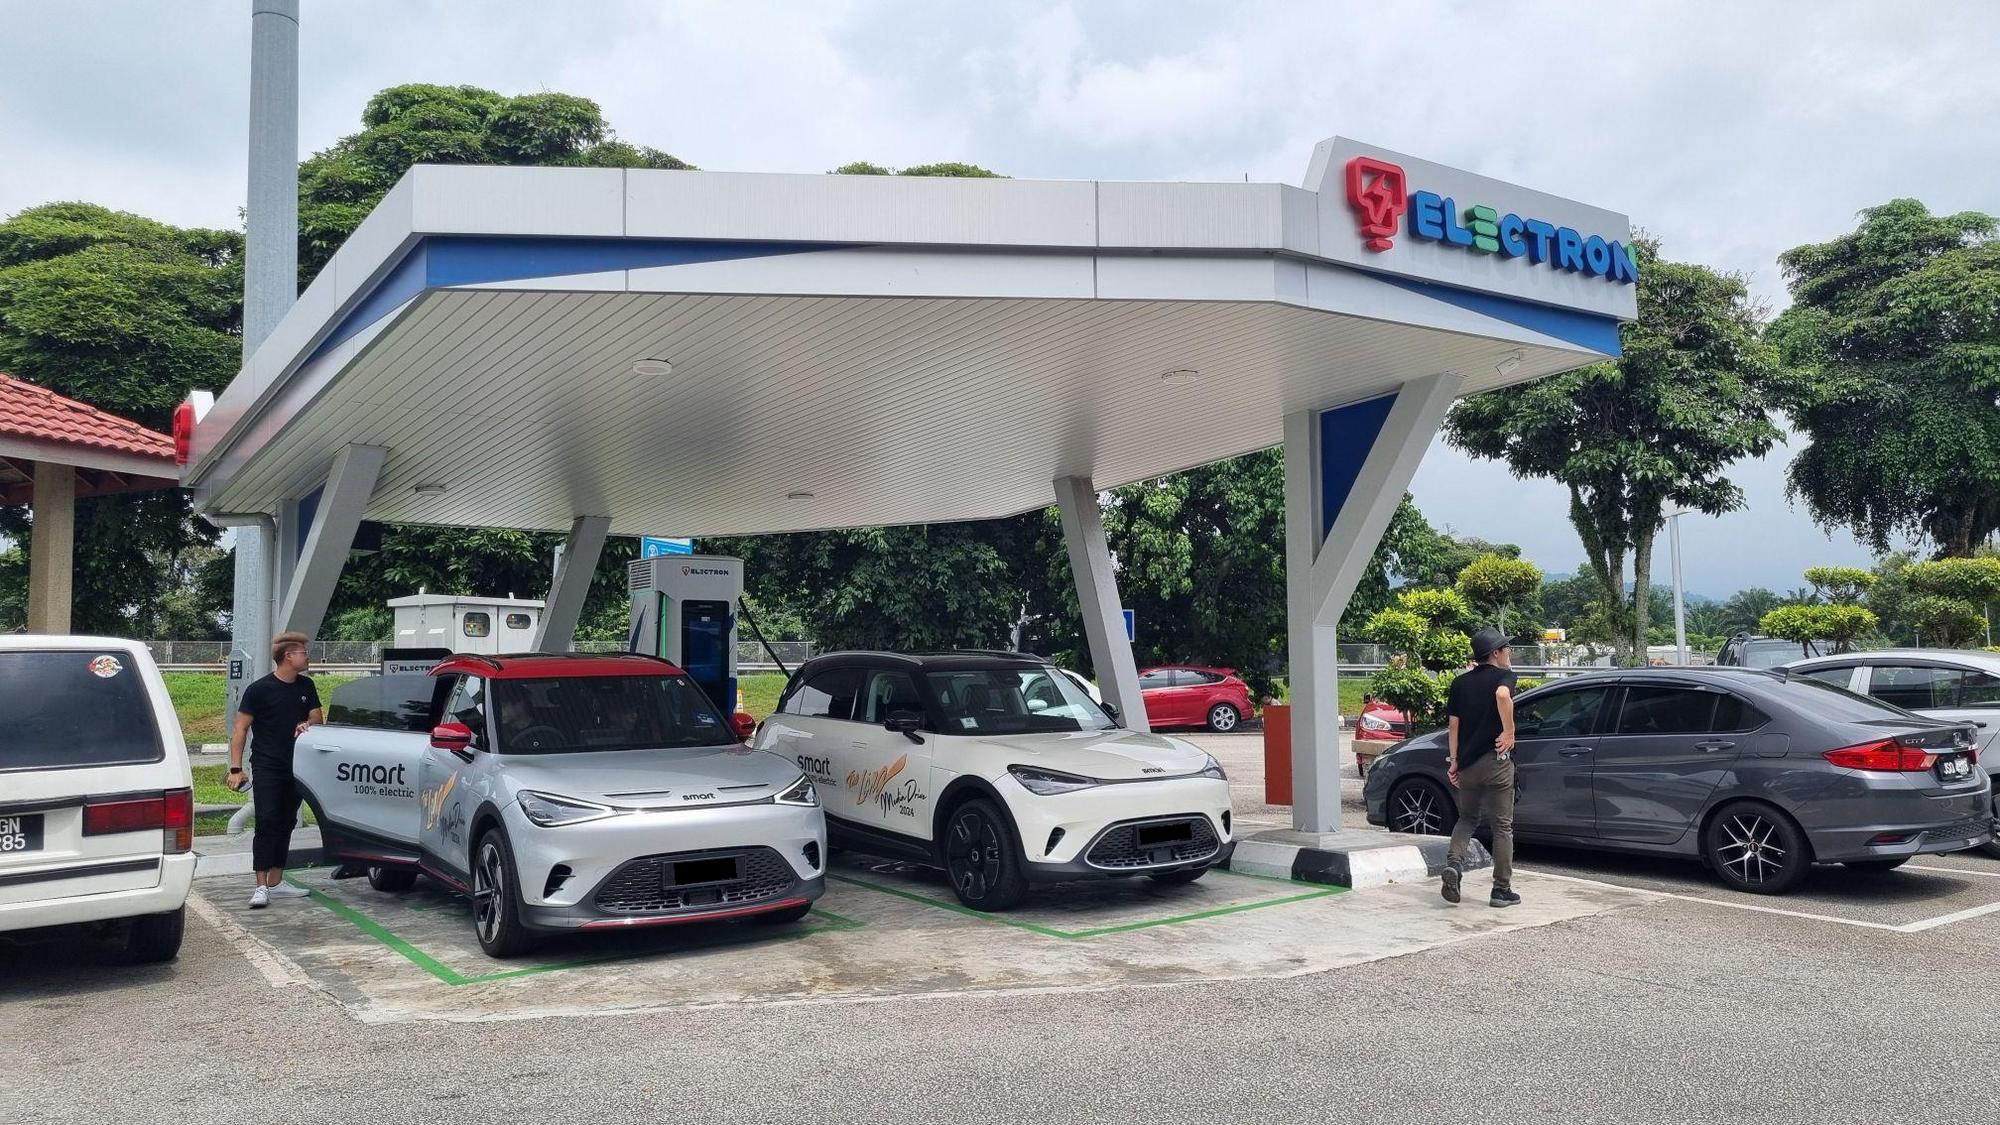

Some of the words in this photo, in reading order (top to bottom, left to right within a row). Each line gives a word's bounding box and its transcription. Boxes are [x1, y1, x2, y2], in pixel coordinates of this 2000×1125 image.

[1409, 191, 1638, 283] ELECTRON
[336, 763, 405, 785] smart
[797, 755, 831, 775] smart
[354, 785, 377, 795] 100%
[379, 786, 415, 798] electric
[682, 793, 716, 801] smart
[899, 805, 915, 817] 2024
[0, 833, 26, 851] 85
